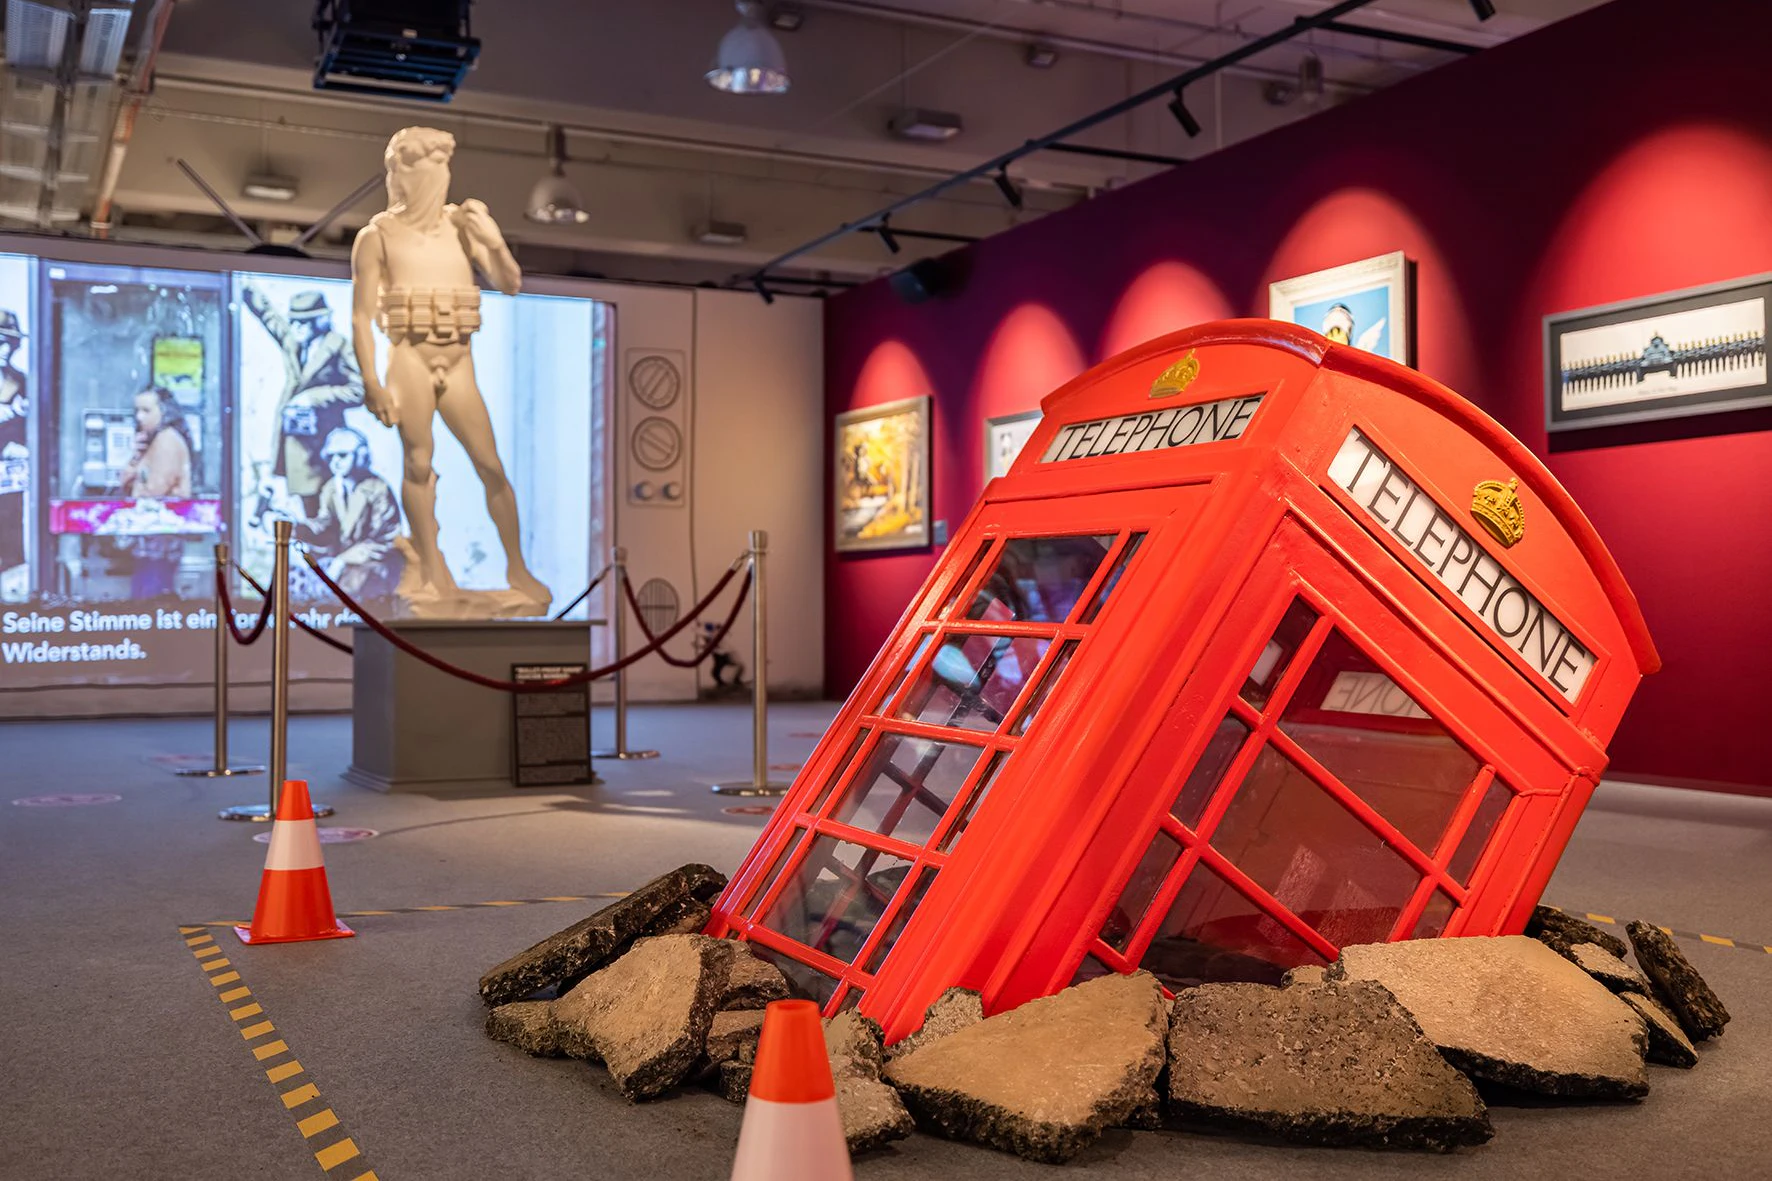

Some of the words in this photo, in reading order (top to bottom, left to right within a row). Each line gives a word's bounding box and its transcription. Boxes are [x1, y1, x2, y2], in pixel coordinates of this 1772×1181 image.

[1053, 396, 1262, 462] TELEPHONE
[1346, 432, 1586, 693] TELEPHONE
[3, 611, 65, 633] Seine
[69, 610, 152, 632] Stimme
[156, 608, 183, 630] ist
[186, 608, 217, 630] ein
[1, 637, 147, 664] Widerstands.
